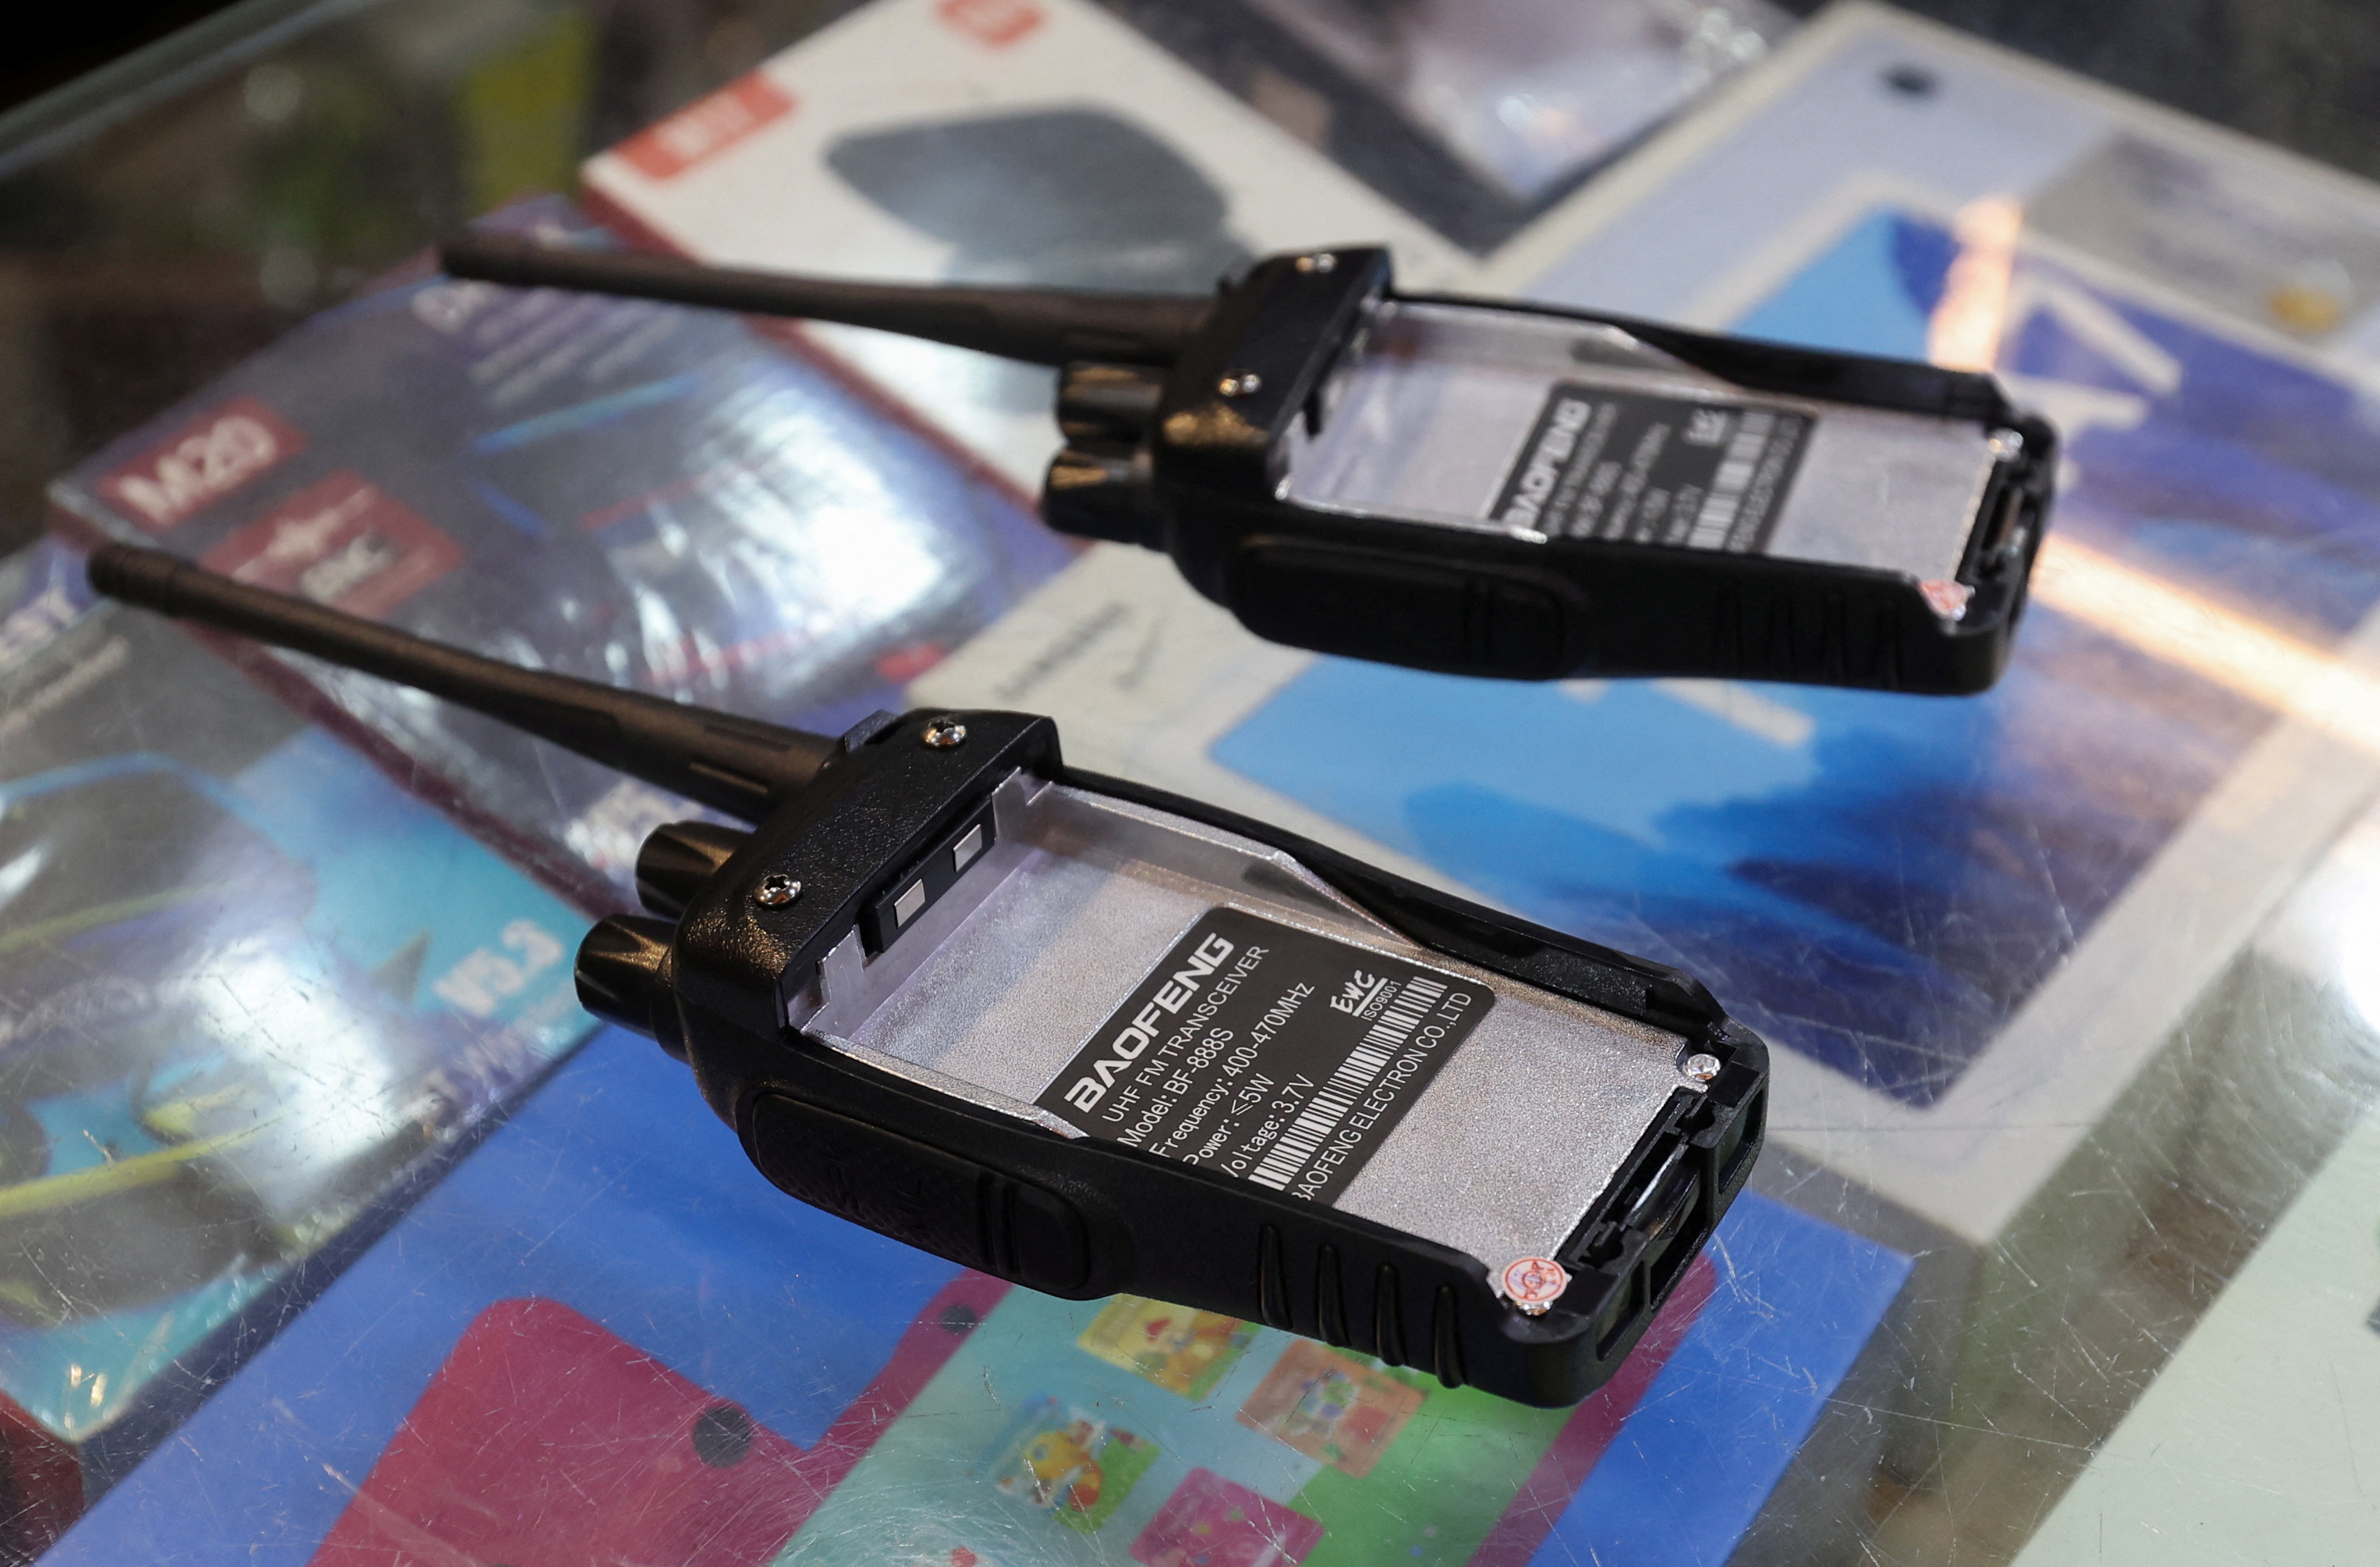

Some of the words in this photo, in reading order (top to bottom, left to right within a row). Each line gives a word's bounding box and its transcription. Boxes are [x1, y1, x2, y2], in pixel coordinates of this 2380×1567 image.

[1064, 932, 1234, 1114] BAOFENG
[1102, 1084, 1141, 1123] UHF
[1135, 1058, 1169, 1086] FM
[1157, 945, 1270, 1057] TRANSCEIVER
[1348, 1047, 1429, 1130] ELECTRON
[1415, 992, 1472, 1049] CO.,LTD
[1360, 980, 1402, 1022] ISO9001
[1116, 1093, 1178, 1148] Model:
[1162, 1027, 1234, 1096] BF-888S
[1149, 1077, 1234, 1159] Frequency:
[1222, 982, 1316, 1077] 400-470MHz
[1231, 1073, 1275, 1116] ≤5W
[1271, 1073, 1315, 1114] 3.7V
